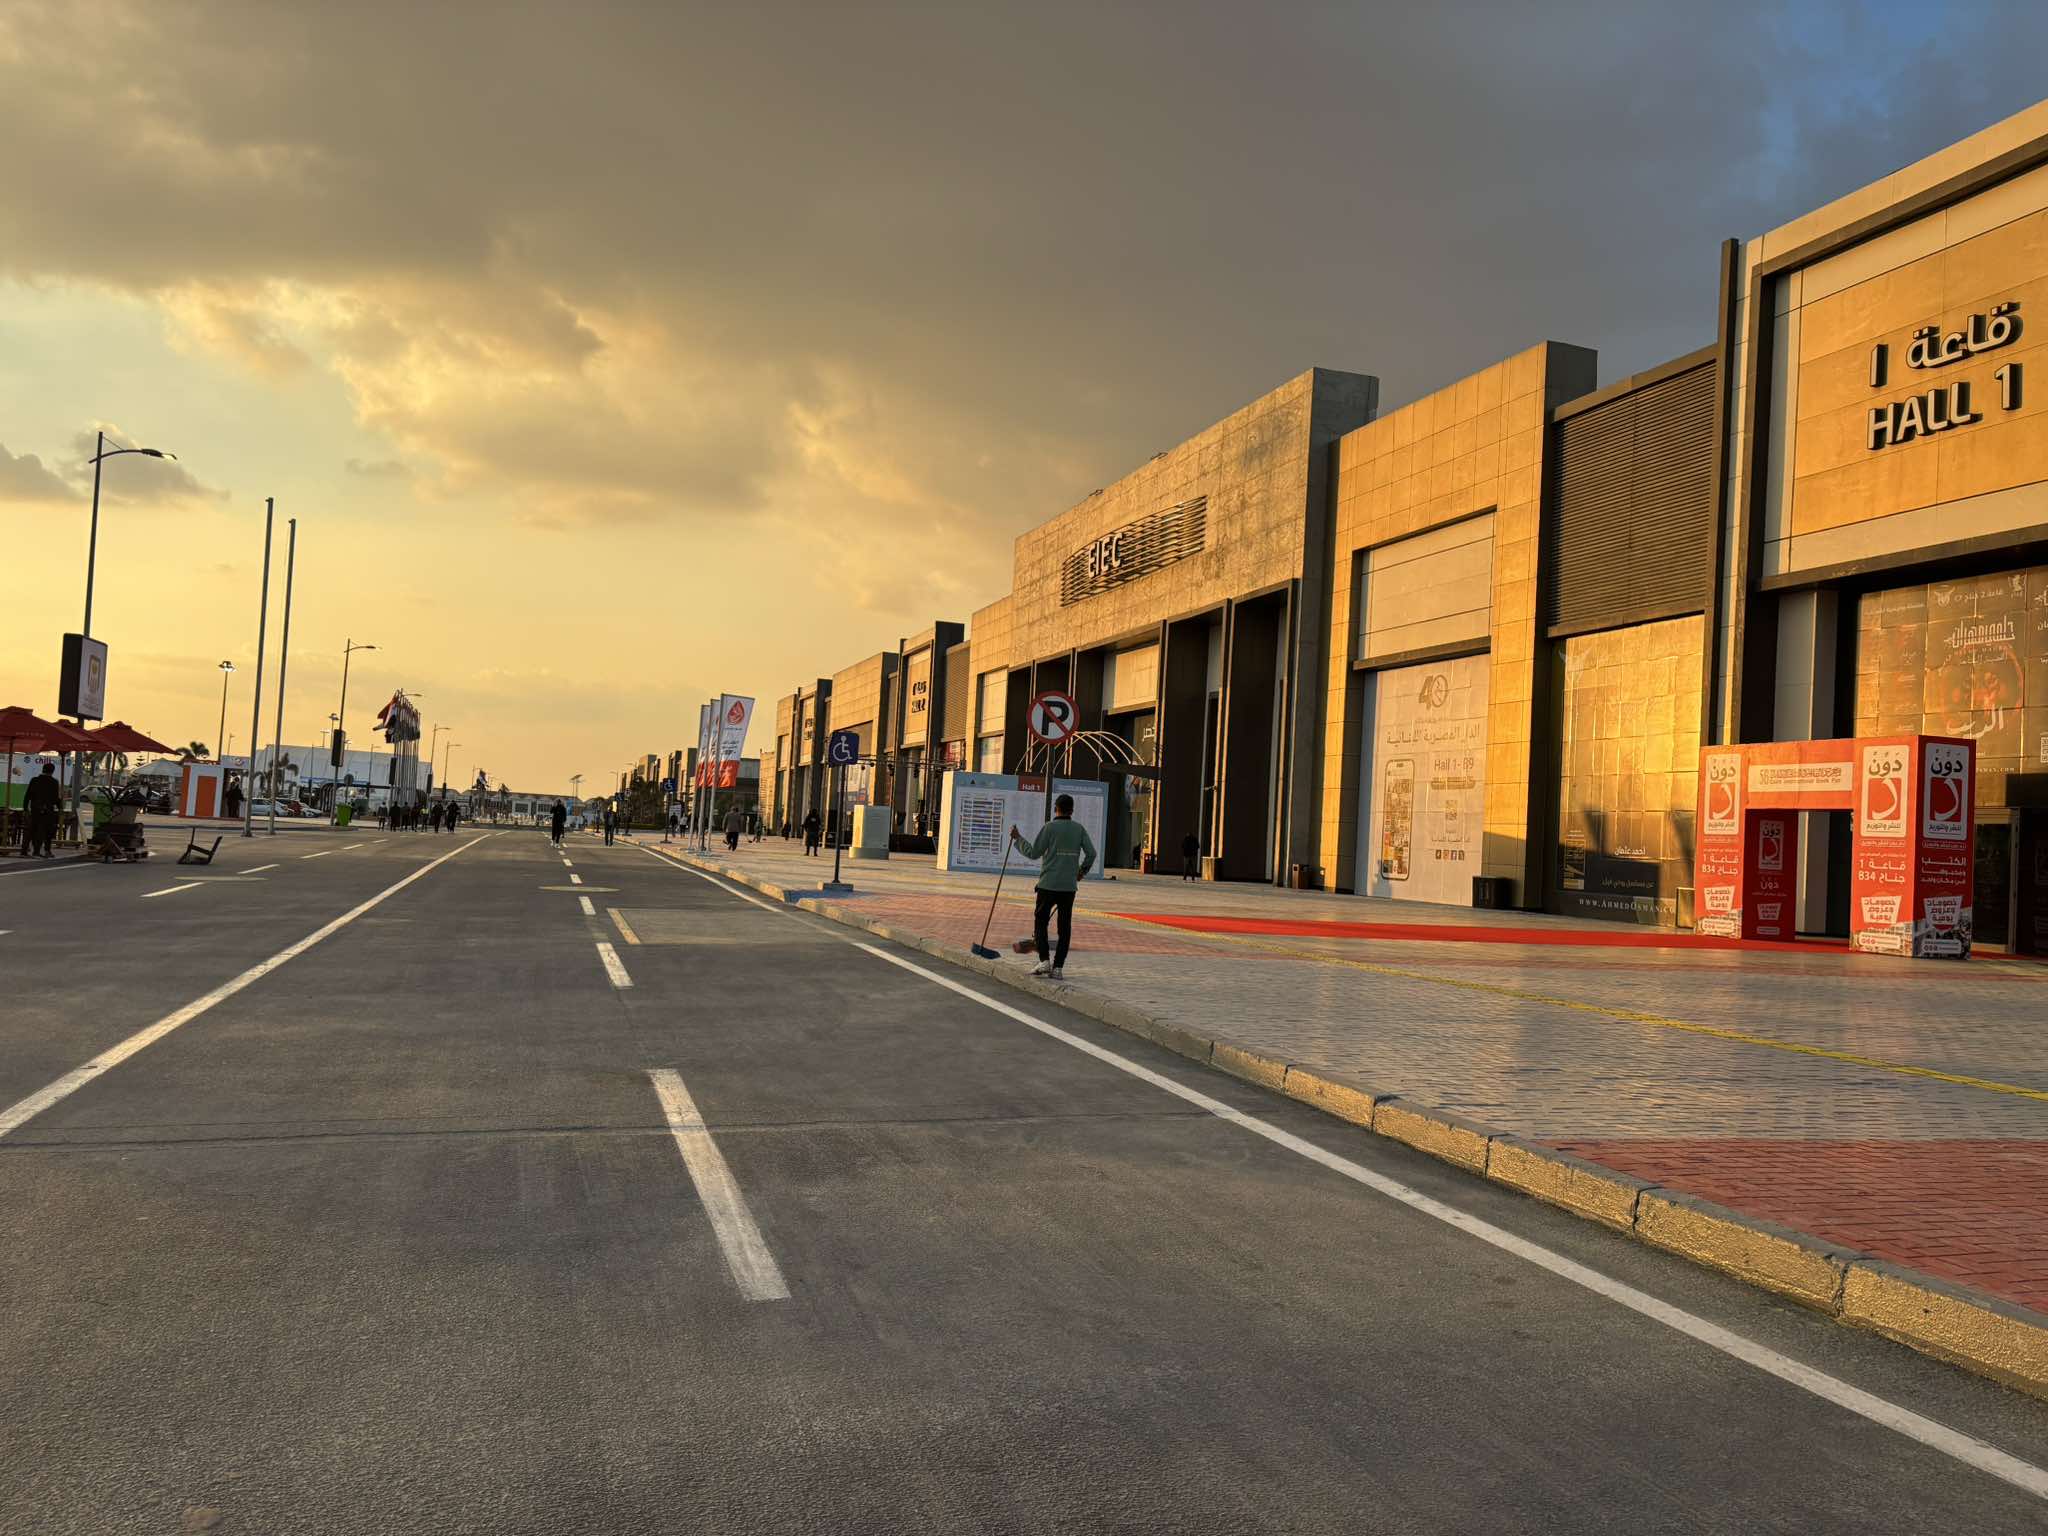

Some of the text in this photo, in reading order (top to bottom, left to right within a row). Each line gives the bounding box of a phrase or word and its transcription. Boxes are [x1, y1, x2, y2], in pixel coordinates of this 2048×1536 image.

[1906, 302, 2023, 369] قاعة
[1867, 363, 2023, 450] HALL 1
[1088, 532, 1123, 577] EIEC
[1041, 701, 1070, 735] P
[1710, 854, 1739, 864] قاعة
[1859, 858, 1906, 870] قاعة 1
[1702, 864, 1738, 876] جناح B34
[1858, 871, 1905, 884] جناح B34
[1864, 897, 1896, 906] خصومات
[1926, 898, 1957, 906] خصومات
[1867, 906, 1894, 914] وعروض
[1930, 906, 1956, 914] وعروض
[1870, 913, 1892, 922] يومية
[1931, 914, 1954, 923] يومية
